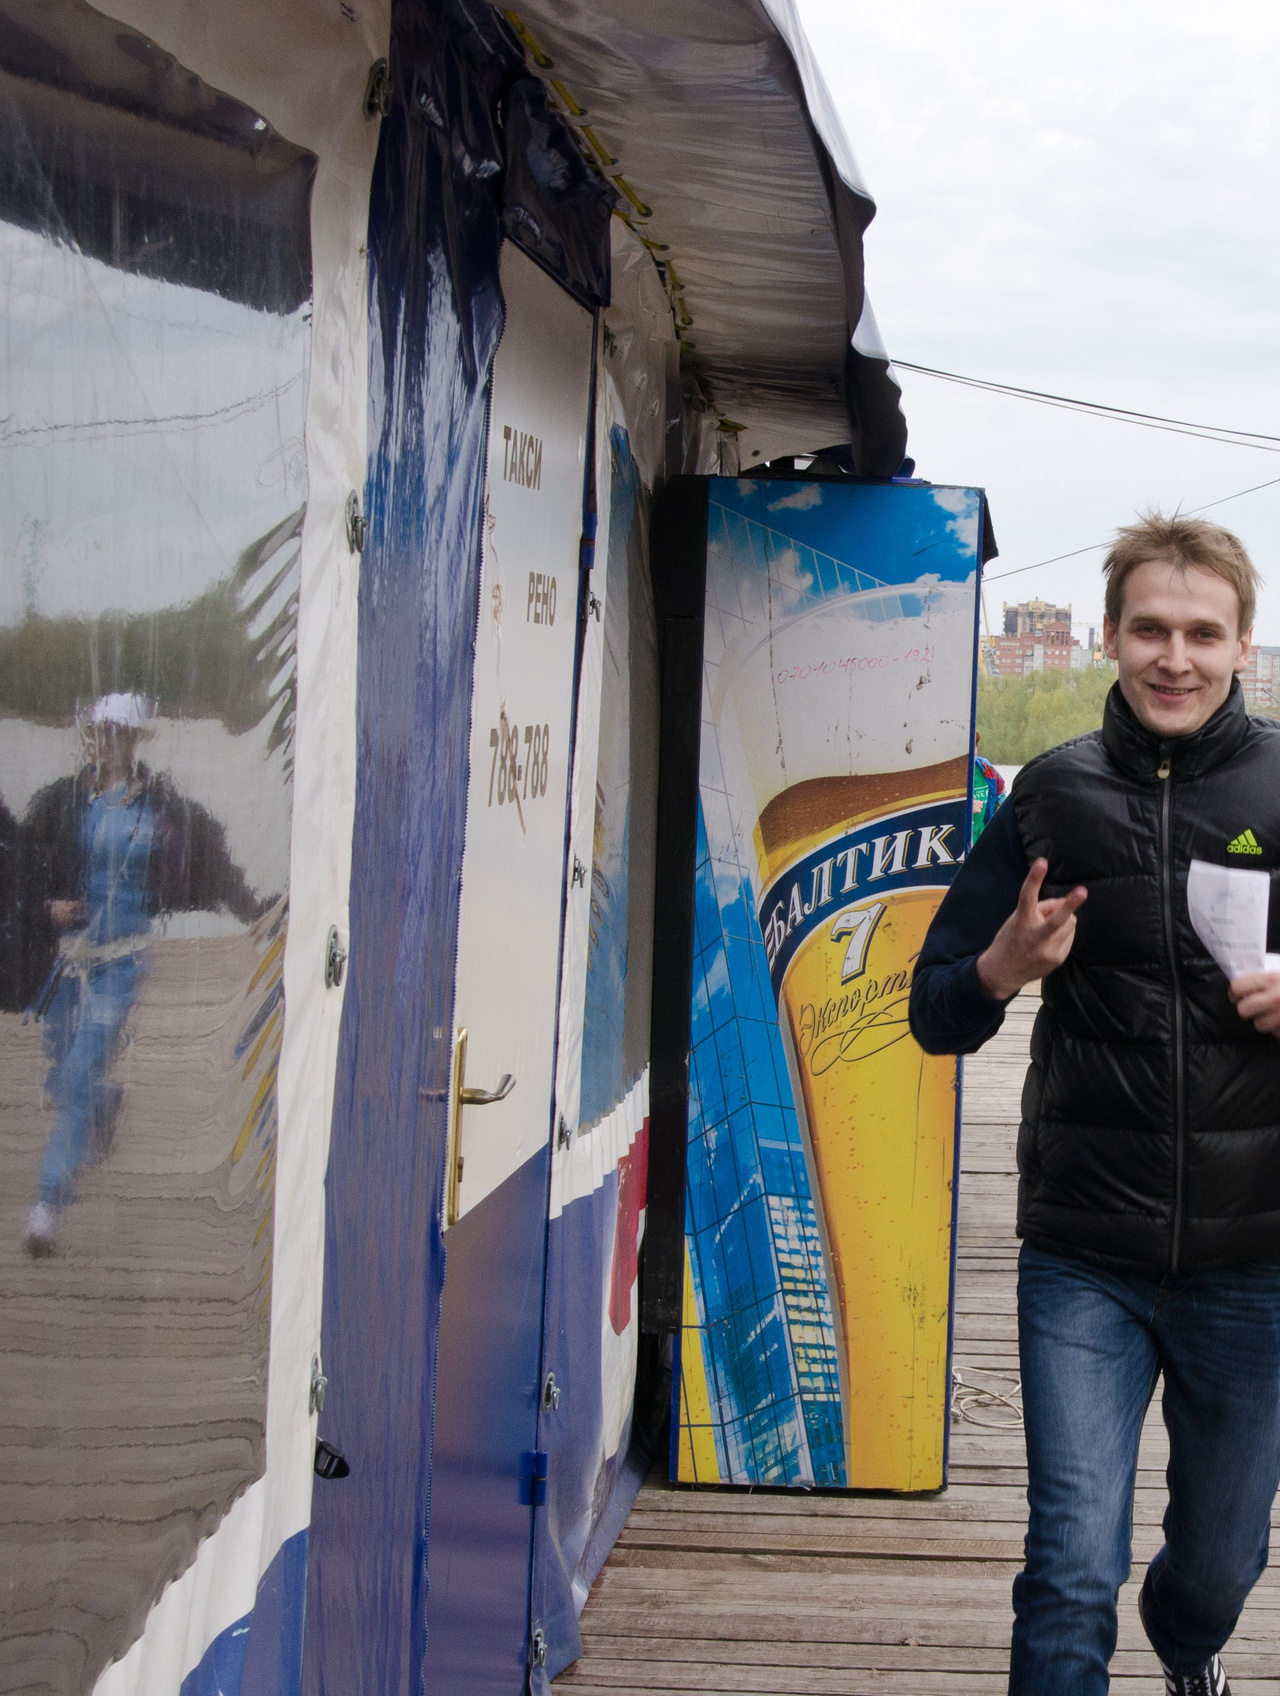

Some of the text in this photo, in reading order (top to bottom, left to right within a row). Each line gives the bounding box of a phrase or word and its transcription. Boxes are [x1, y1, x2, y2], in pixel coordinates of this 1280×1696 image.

[503, 424, 542, 491] ТАКСИ
[526, 570, 557, 627] РЕНО
[488, 723, 549, 807] 788-788
[1226, 844, 1262, 855] adidas
[765, 824, 965, 972] БАЛТИК
[831, 902, 887, 986] 7
[799, 969, 913, 1058] Экспорт
